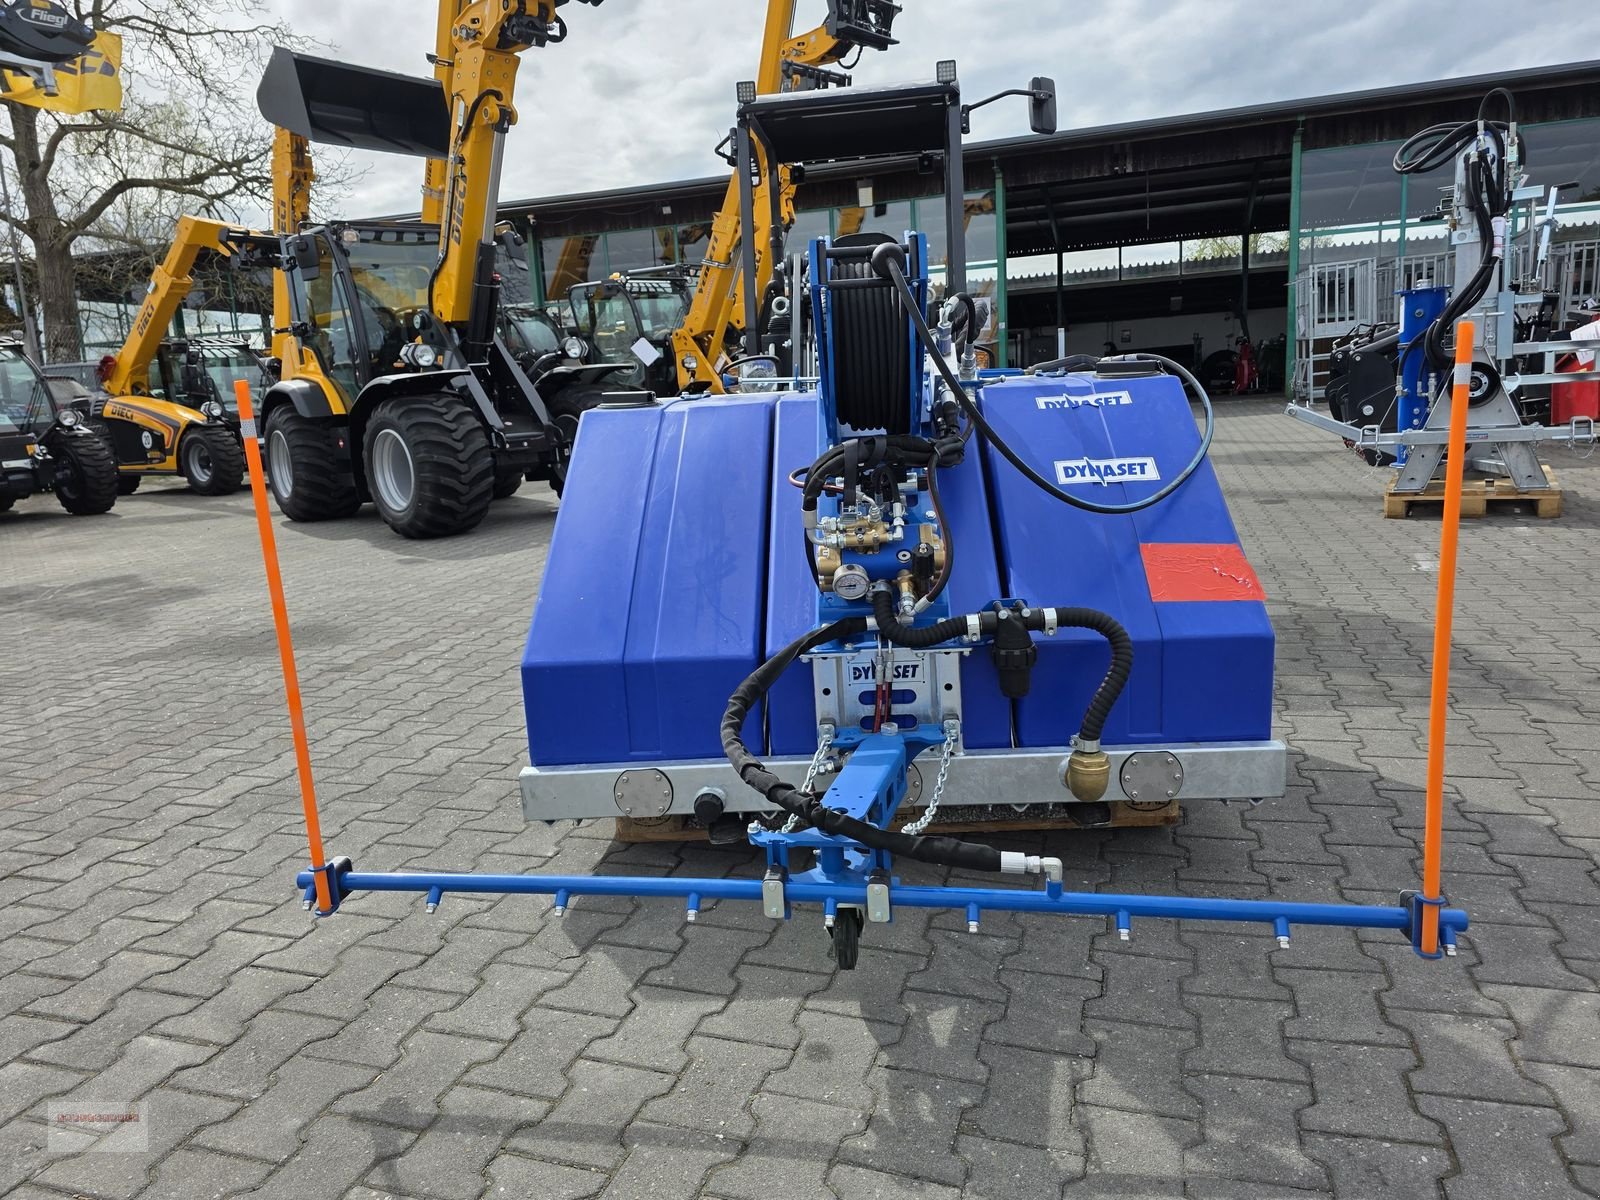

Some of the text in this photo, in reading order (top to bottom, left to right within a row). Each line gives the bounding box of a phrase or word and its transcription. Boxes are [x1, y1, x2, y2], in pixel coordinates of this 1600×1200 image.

[30, 8, 68, 28] Fliegl
[111, 405, 134, 420] DIECI
[144, 434, 151, 446] 20
[1062, 459, 1148, 484] DYNASET
